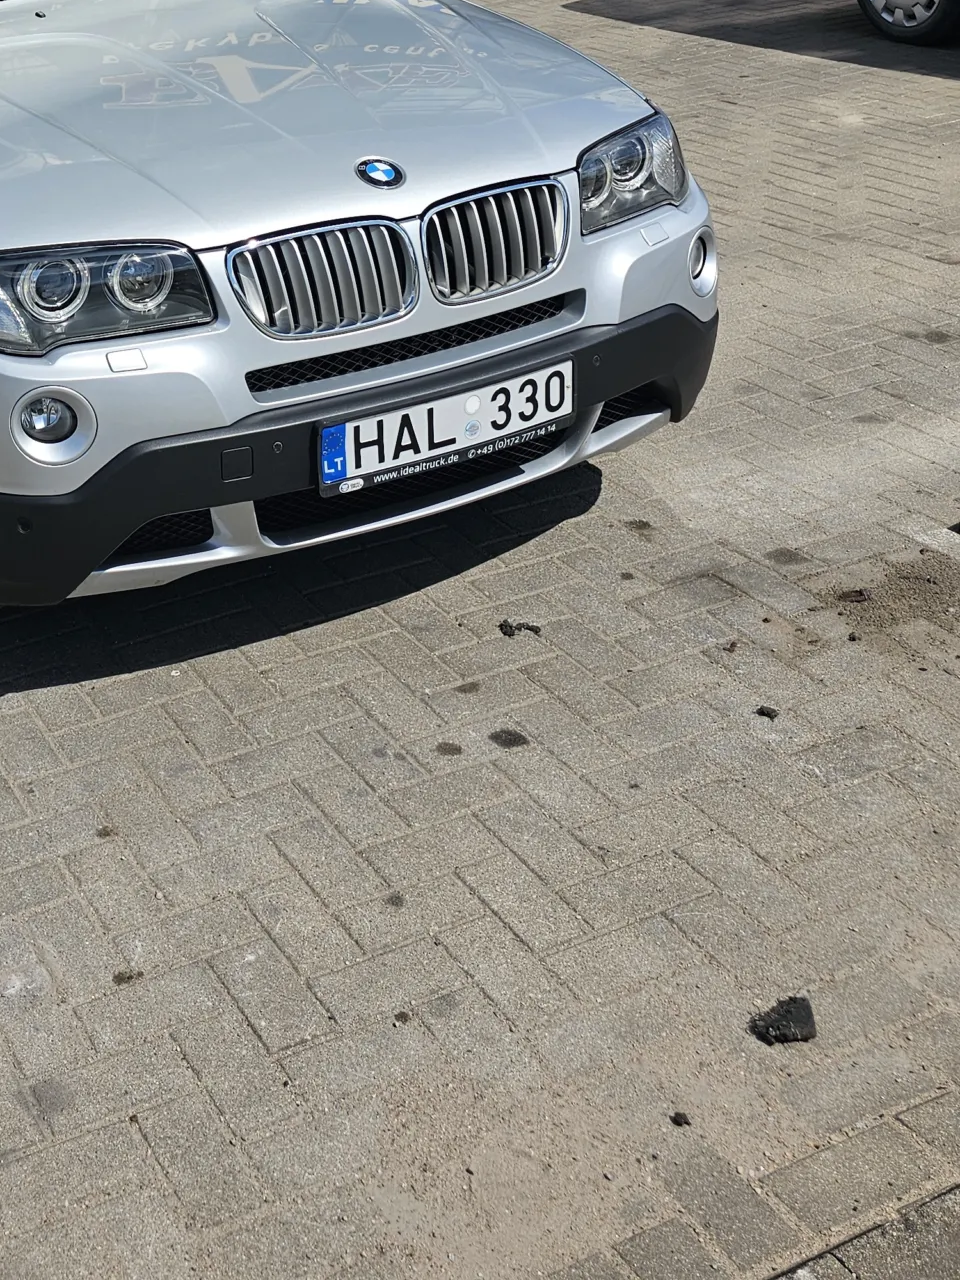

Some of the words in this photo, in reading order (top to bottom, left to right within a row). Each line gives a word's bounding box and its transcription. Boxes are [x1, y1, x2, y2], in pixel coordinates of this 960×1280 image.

[352, 407, 457, 470] HAL
[490, 370, 566, 431] 330
[323, 456, 344, 474] LT
[373, 453, 459, 483] www.idealtruck.de
